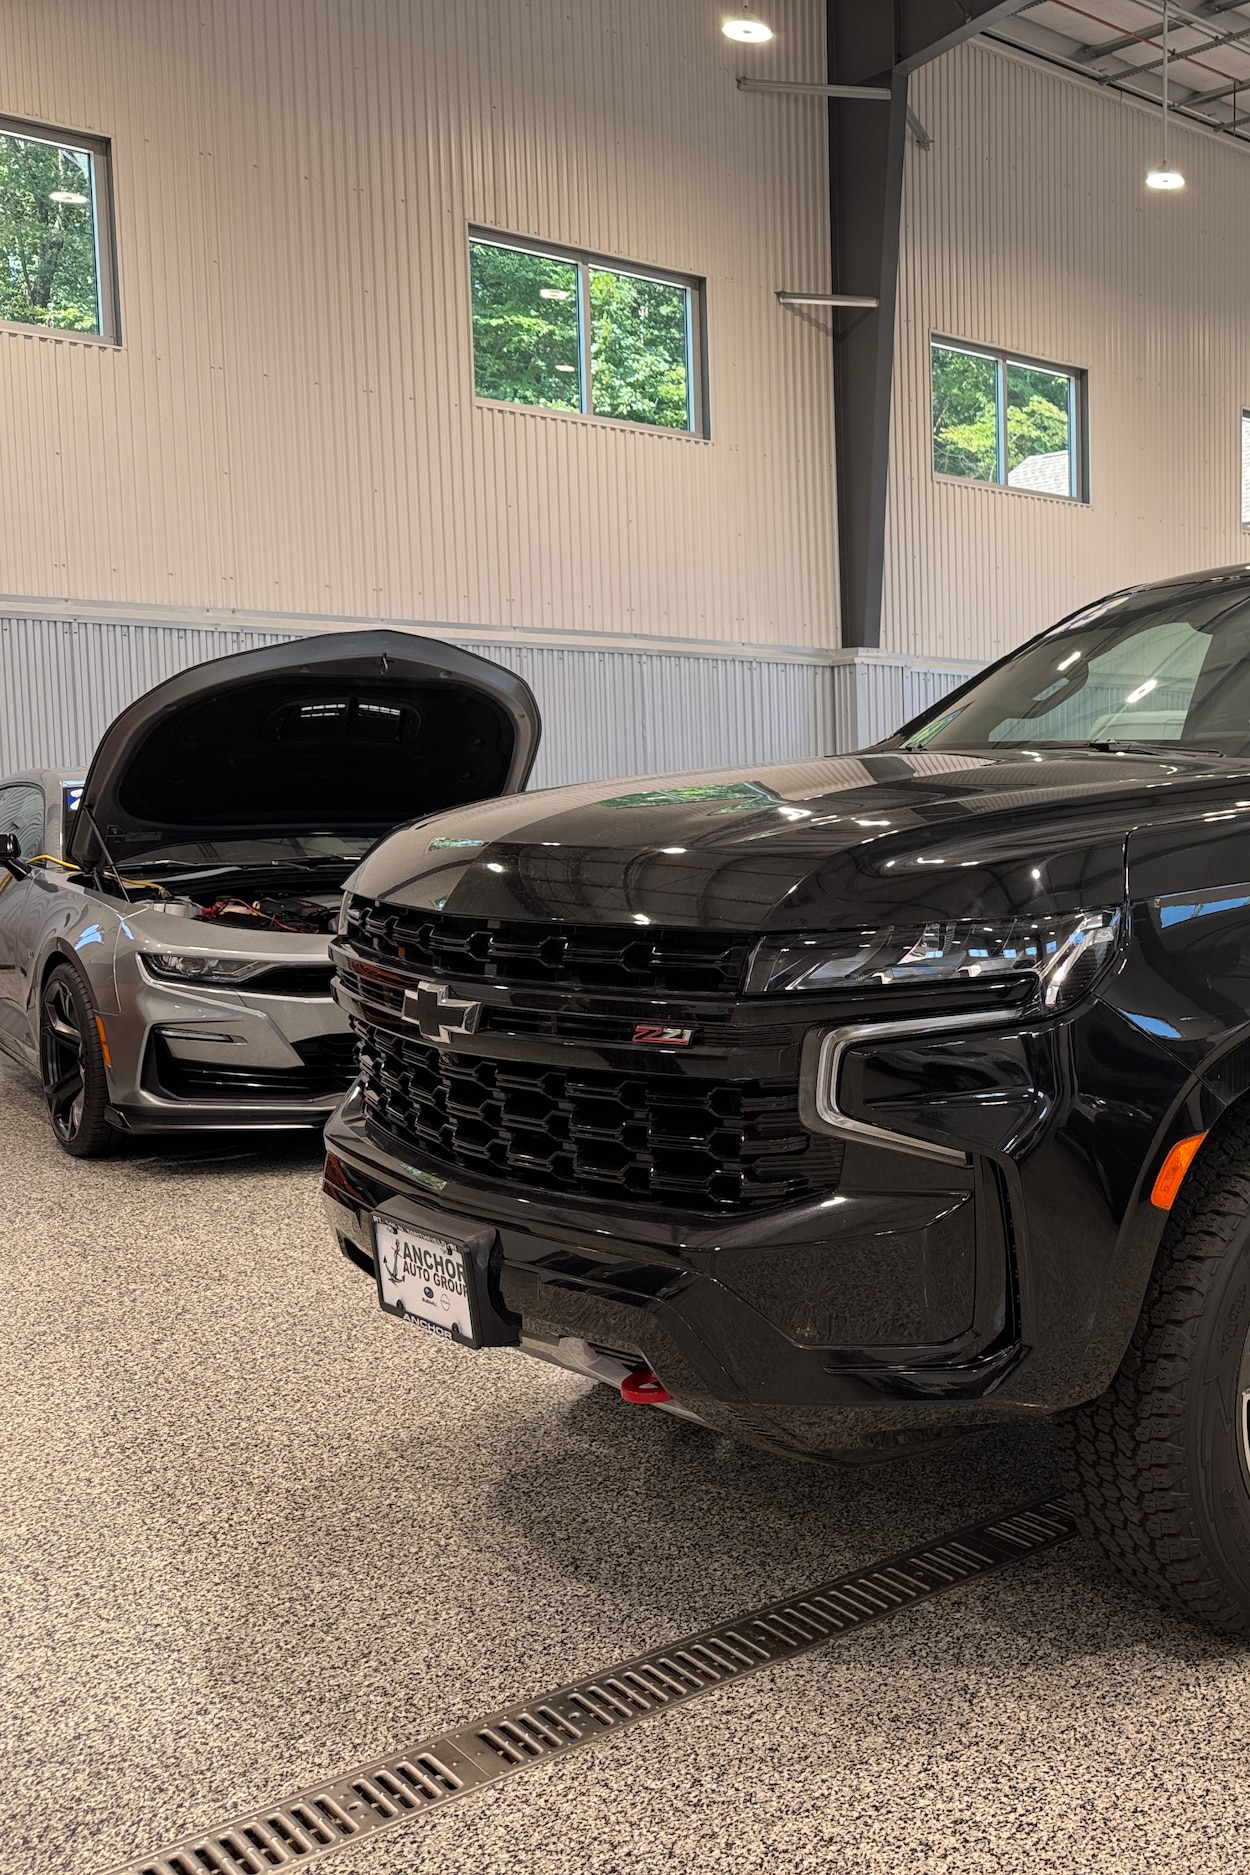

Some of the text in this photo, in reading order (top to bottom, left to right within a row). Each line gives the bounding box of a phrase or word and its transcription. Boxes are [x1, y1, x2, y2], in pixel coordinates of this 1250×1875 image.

[632, 1025, 693, 1045] Z71
[403, 1242, 467, 1285] ANCHOR
[403, 1260, 430, 1282] AUTO
[403, 1312, 452, 1339] ANCHOR
